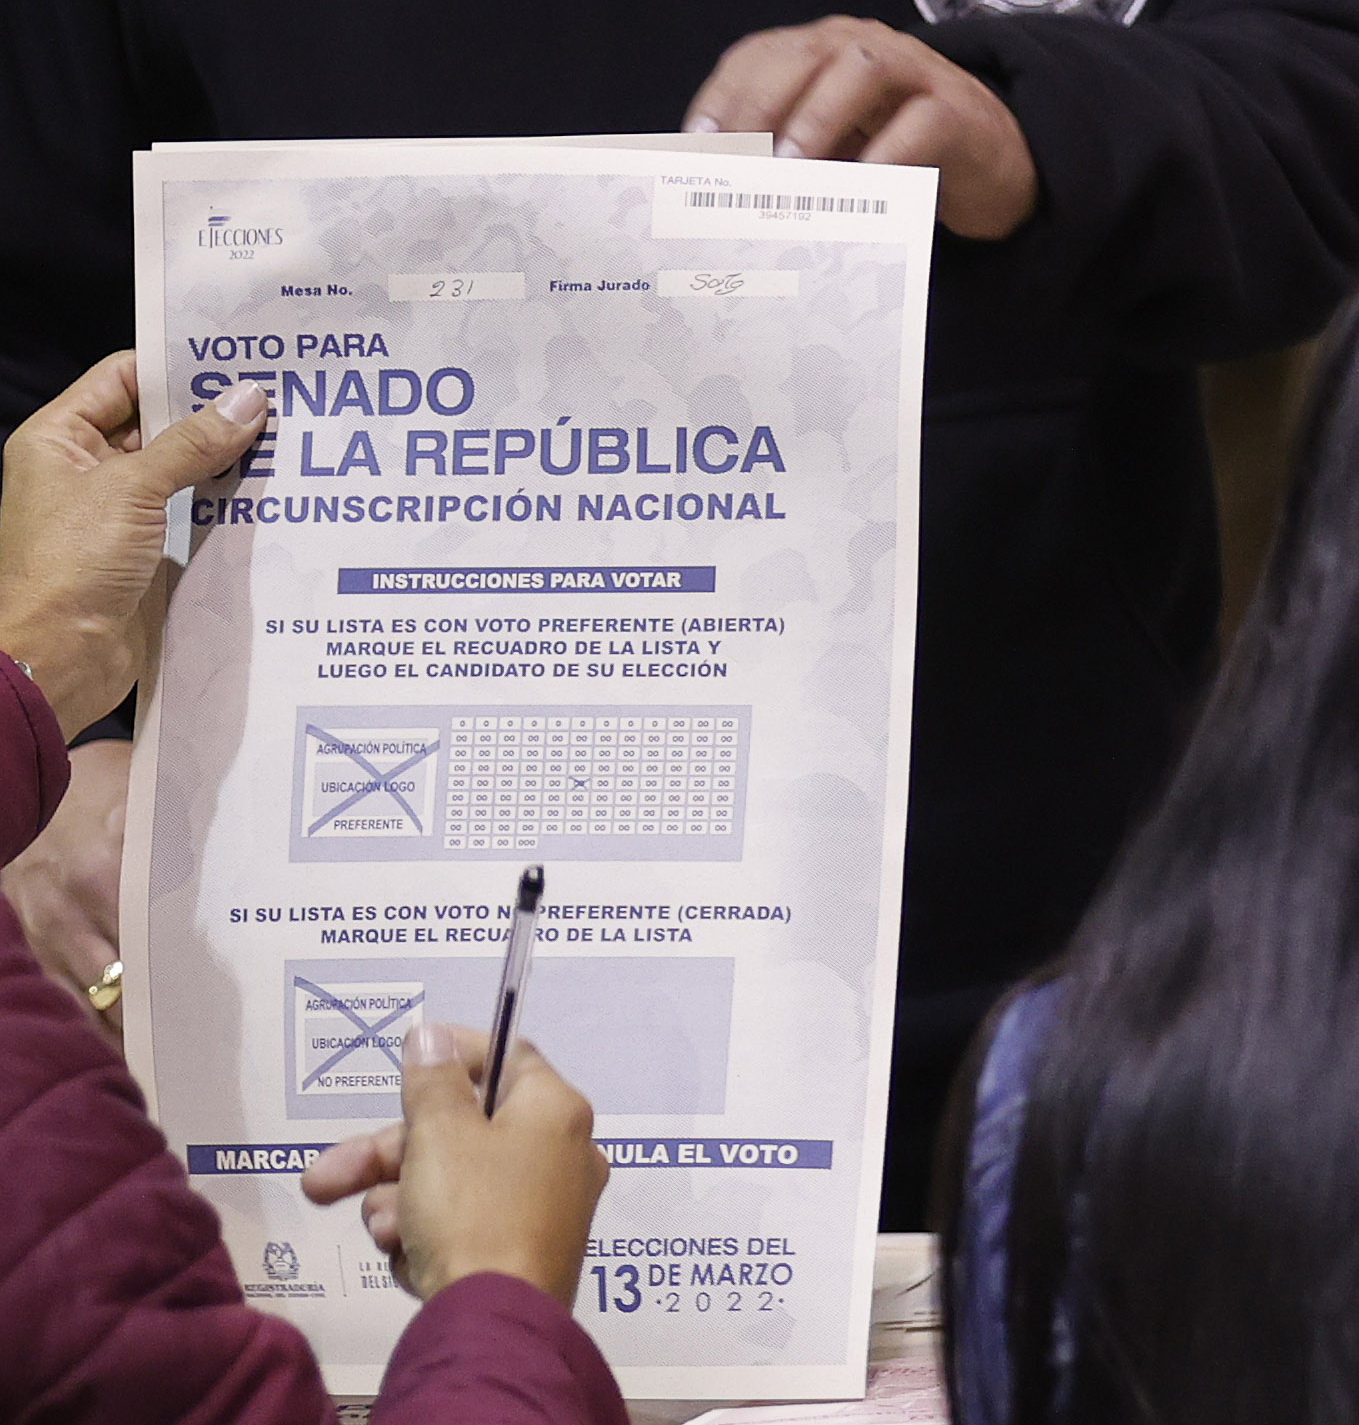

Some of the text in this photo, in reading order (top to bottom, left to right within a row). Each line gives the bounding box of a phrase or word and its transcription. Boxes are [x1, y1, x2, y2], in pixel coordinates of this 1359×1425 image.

[660, 176, 732, 187] TARJETA No.
[228, 249, 255, 260] 2022
[281, 284, 353, 296] Mesa No.
[549, 278, 651, 293] Firma Jurado
[188, 333, 390, 362] VOTO PARA
[300, 430, 380, 477] LA
[405, 414, 787, 476] REPÚBLICA
[191, 487, 787, 526] CIRCUNSCRIPCIÓN NACIONAL
[372, 571, 682, 589] INSTRUCCIONES PARA VOTAR
[265, 617, 785, 636] SI SU LISTA ES CON VOTO PREFERENTE (ABIERTA)
[326, 640, 722, 657] MARQUE EL RECUADRO DE LA LISTA Y
[318, 660, 728, 679] LUEGO EL CANDIDATO DE SU ELECCIÓN
[382, 740, 428, 755] POLÍTICA
[321, 779, 415, 793] UBICACIÓN LOGO
[333, 818, 403, 830] PREFERENTE
[229, 908, 248, 923] SI
[255, 907, 282, 923] SU
[289, 906, 345, 922] LISTA
[352, 906, 377, 921] ES
[384, 905, 427, 921] CON
[434, 905, 490, 920] VOTO
[678, 905, 791, 923] (CERRADA)
[321, 928, 407, 944] MARQUE
[414, 928, 439, 943] EL
[567, 927, 593, 942] DE
[600, 927, 626, 942] LA
[634, 928, 692, 943] LISTA
[372, 1036, 402, 1048] LOGO
[318, 1075, 401, 1087] NO PREFERENTE
[678, 1143, 712, 1164] EL
[719, 1143, 799, 1165] VOTO
[584, 1237, 796, 1258] ELECCIONES DEL
[590, 1262, 794, 1313] 13 DE MARZO
